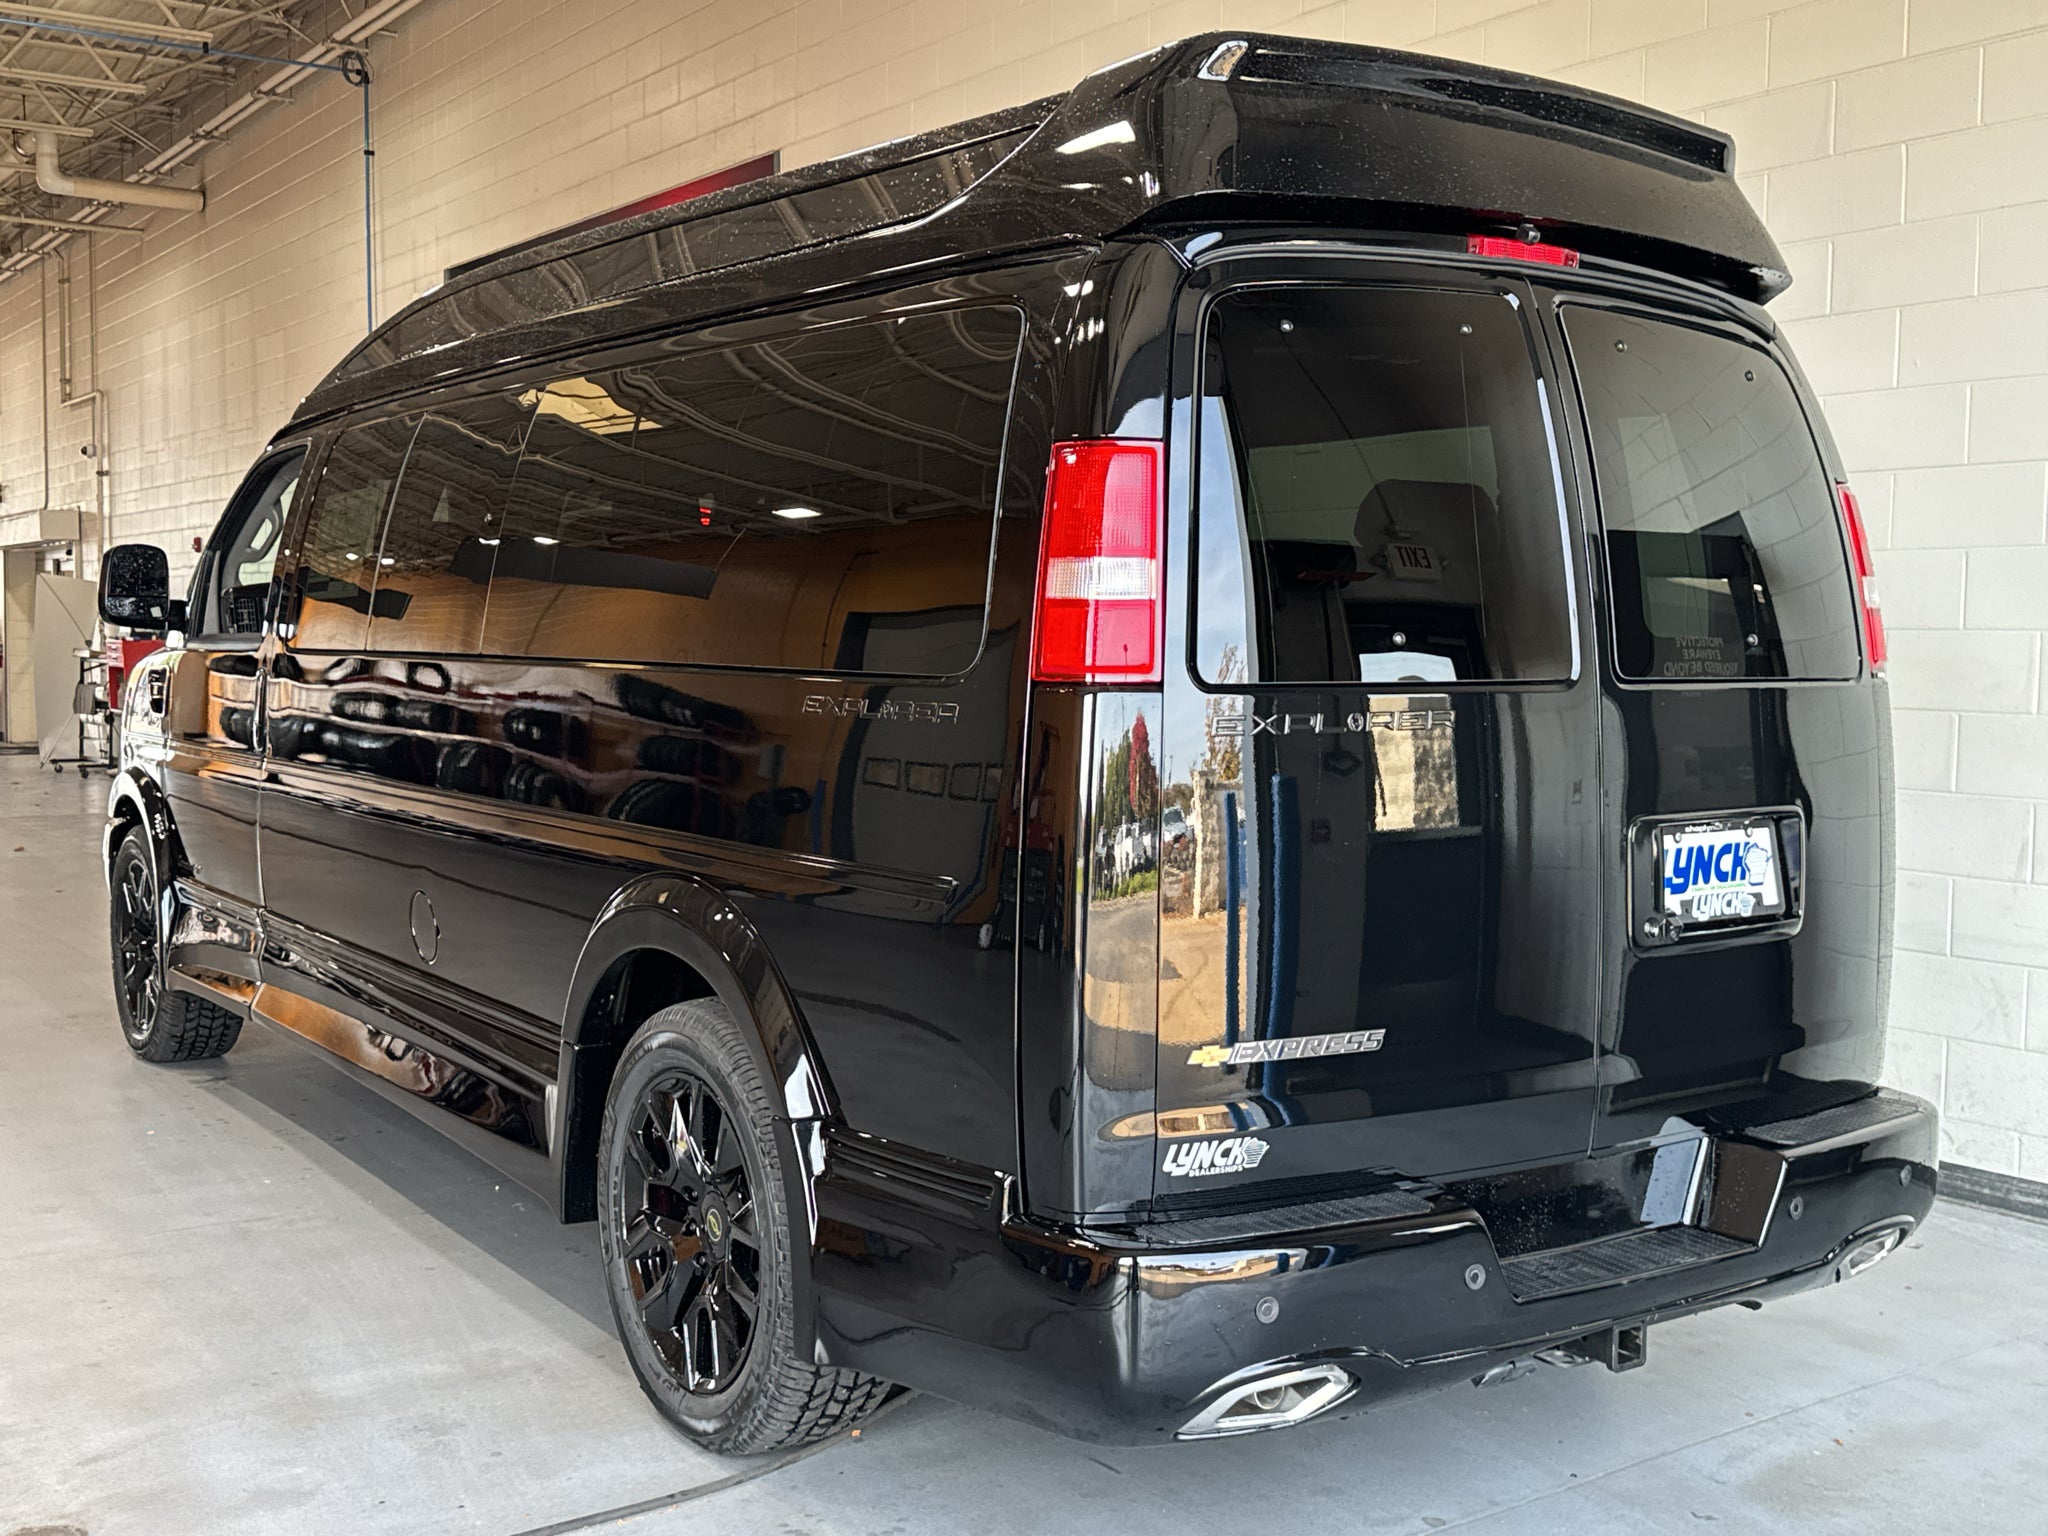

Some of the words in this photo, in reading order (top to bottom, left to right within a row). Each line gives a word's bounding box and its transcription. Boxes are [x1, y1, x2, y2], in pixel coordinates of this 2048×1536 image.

[802, 695, 960, 725] EXPLORER
[1211, 710, 1456, 738] EXPLORER
[1234, 1029, 1386, 1064] EXPRESS
[1188, 1164, 1243, 1177] DEALERSHIPS
